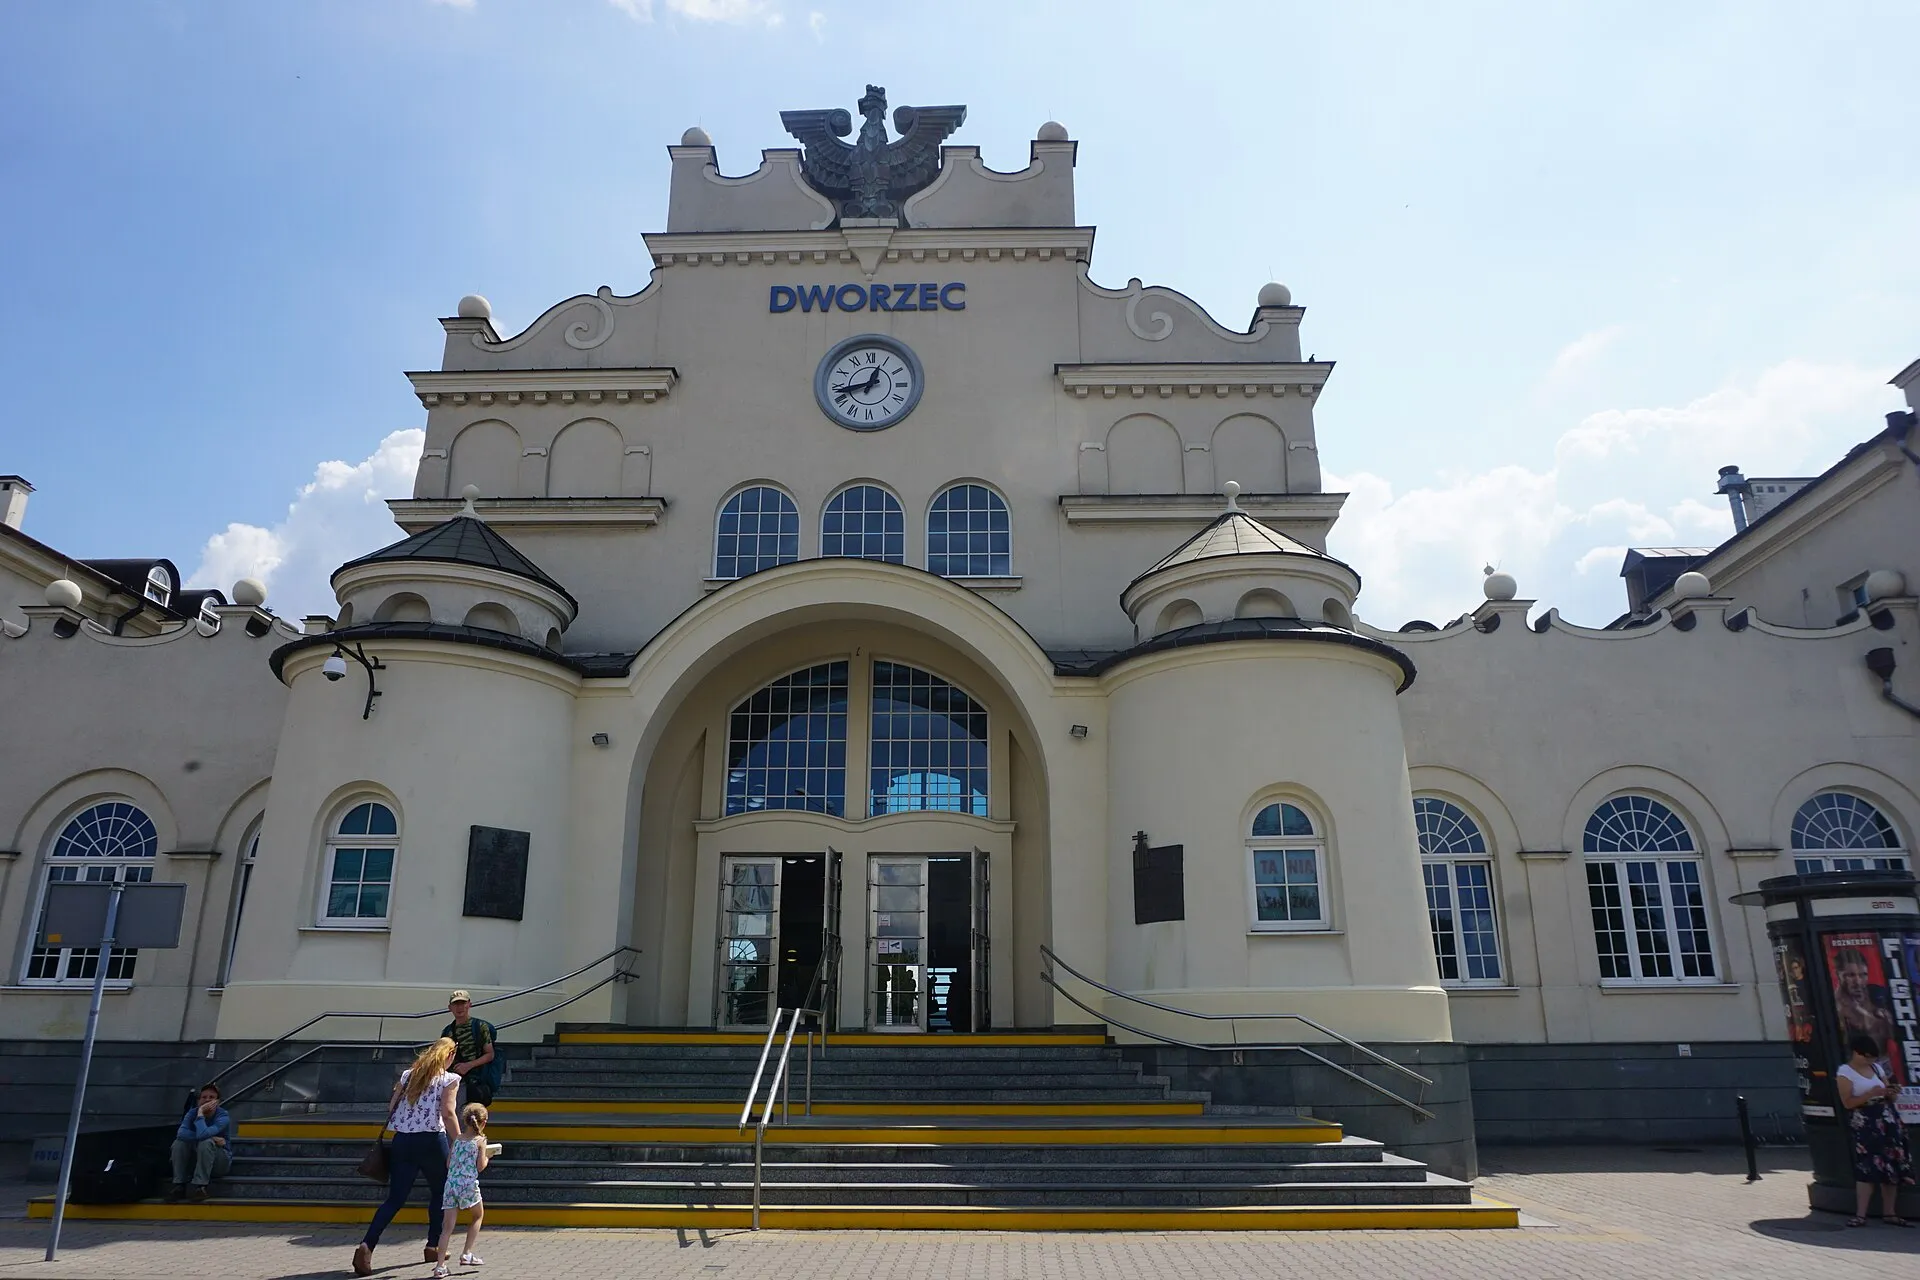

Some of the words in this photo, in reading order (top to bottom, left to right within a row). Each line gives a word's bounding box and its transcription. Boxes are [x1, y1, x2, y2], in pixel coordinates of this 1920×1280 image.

[769, 282, 966, 313] DWORZEC
[865, 352, 876, 364] XII
[1871, 901, 1895, 909] ams
[1881, 938, 1920, 1084] FIGHTER
